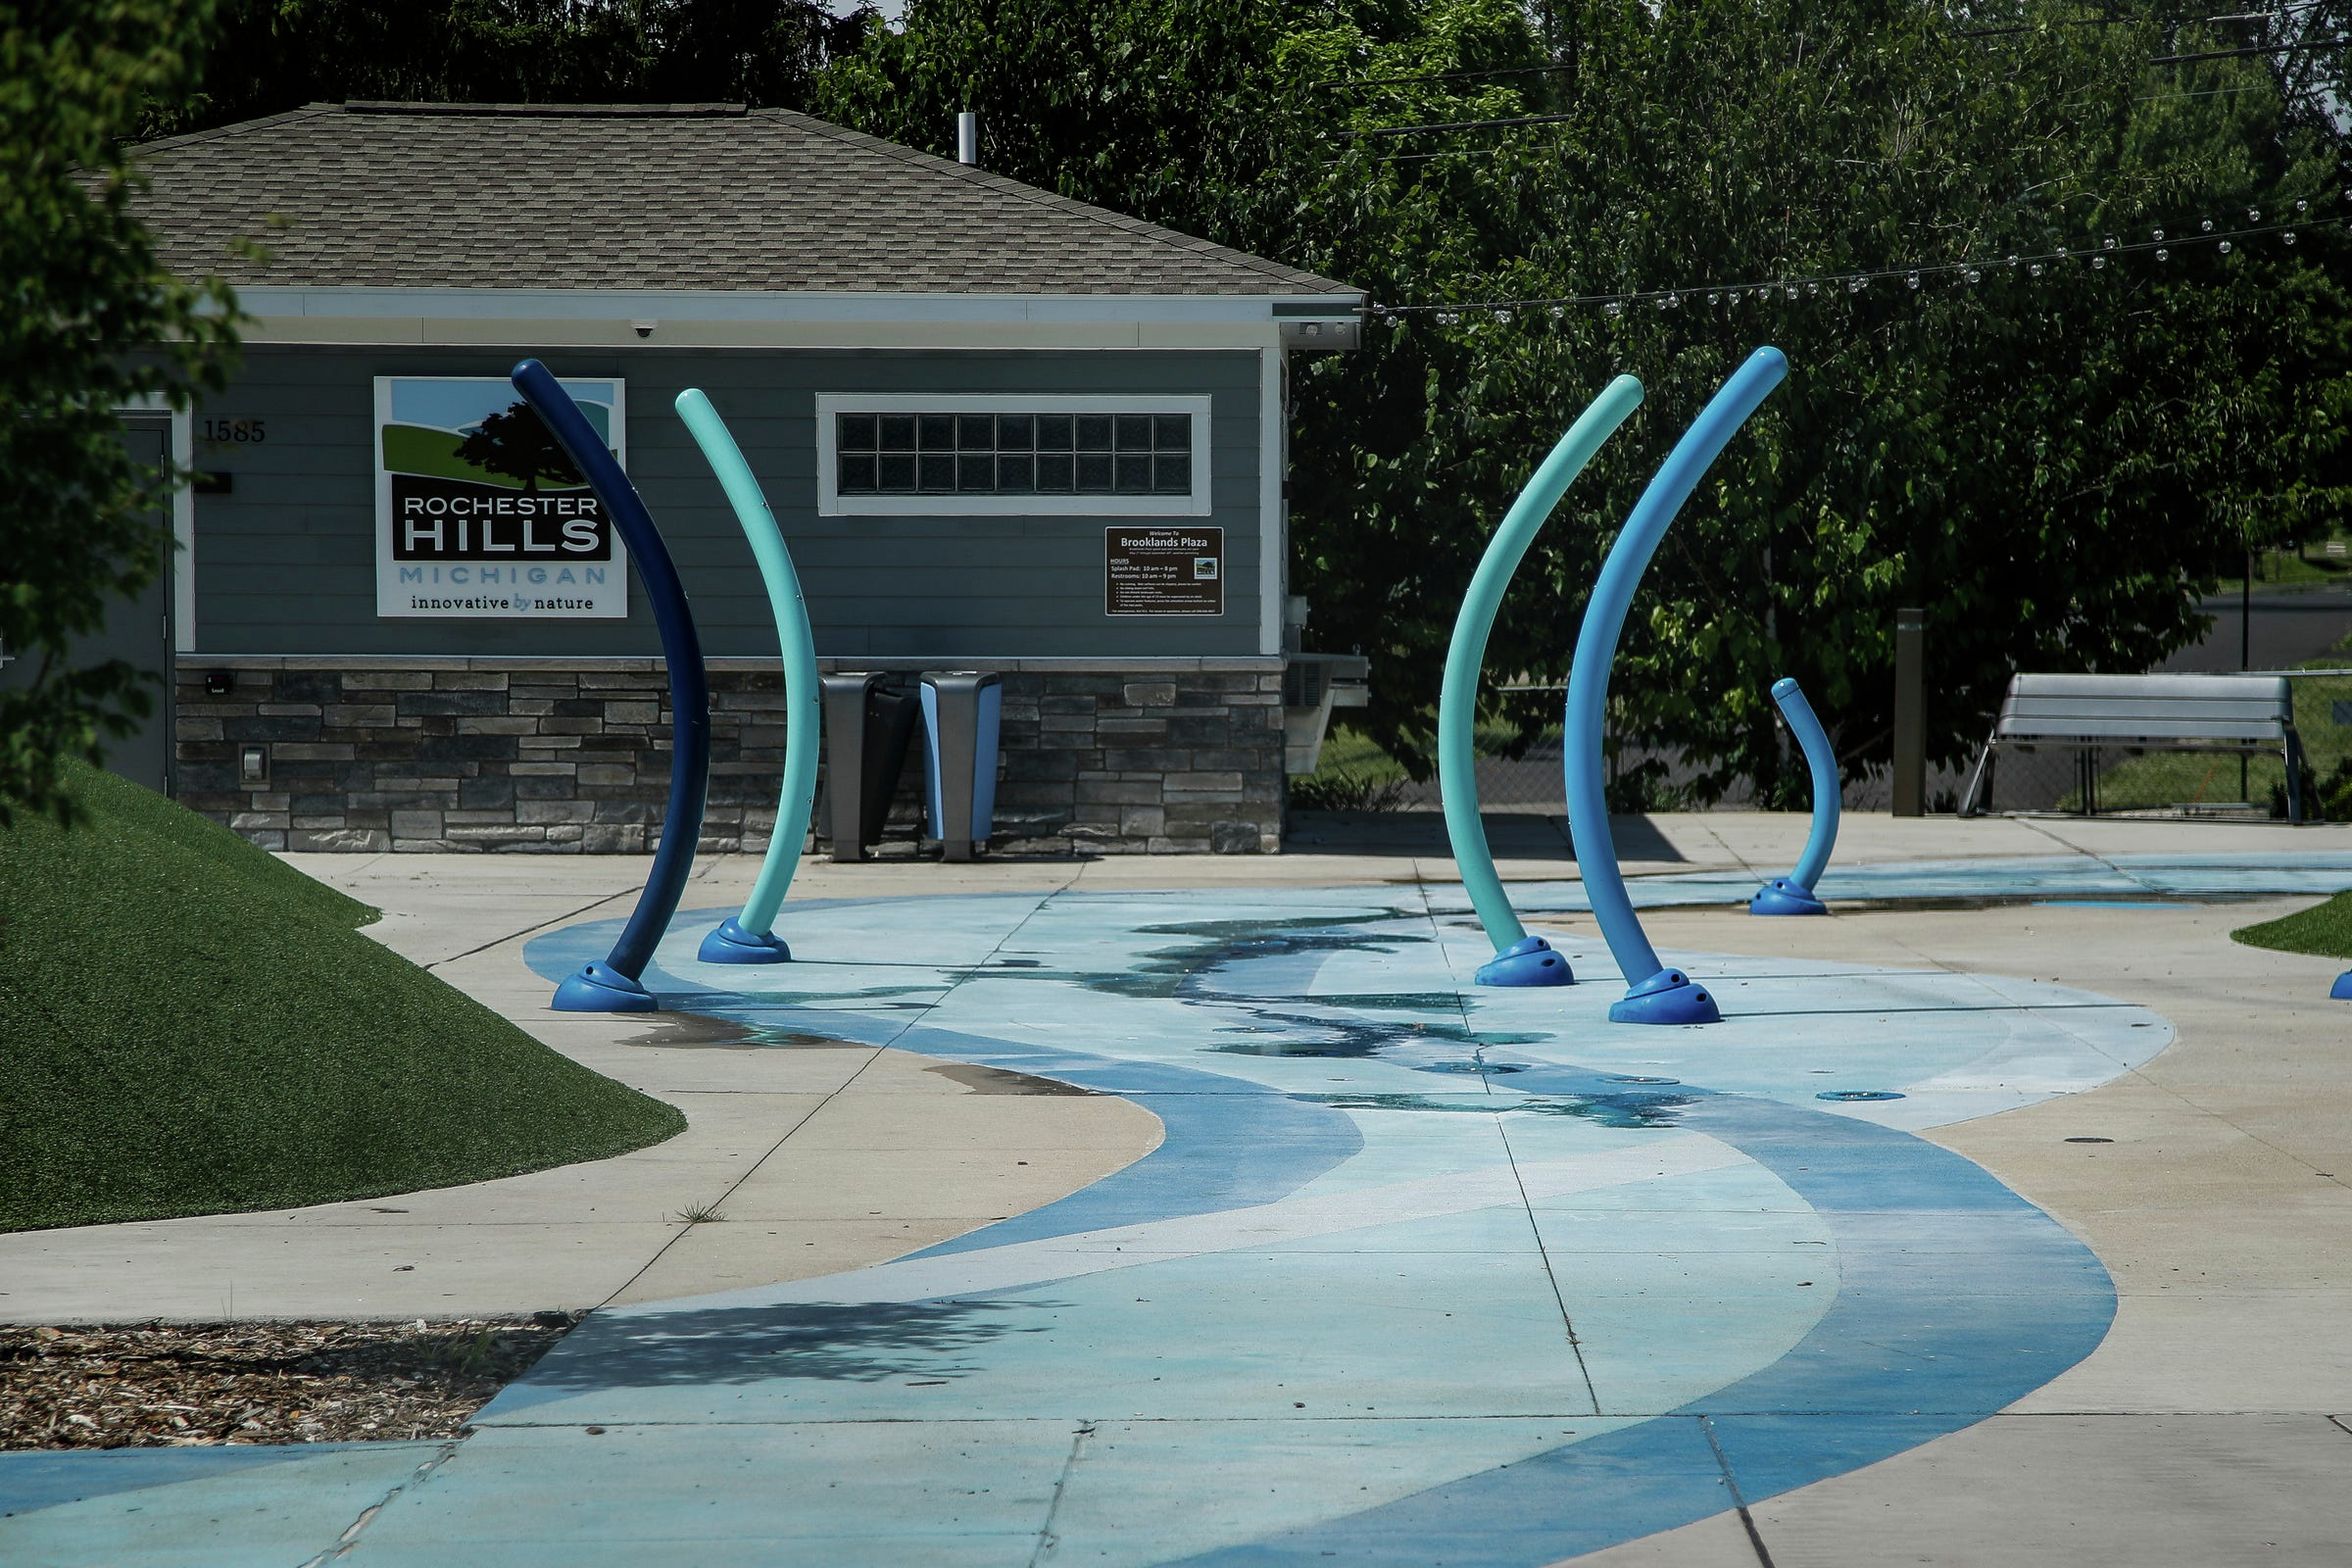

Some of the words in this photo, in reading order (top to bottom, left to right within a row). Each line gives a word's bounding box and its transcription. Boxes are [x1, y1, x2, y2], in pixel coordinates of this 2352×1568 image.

[205, 419, 266, 442] 1585
[404, 497, 598, 515] ROCHESTER
[405, 519, 600, 553] HILLS
[1121, 537, 1178, 547] Brooklands
[1181, 537, 1207, 547] Plaza
[400, 566, 606, 585] MICHIGAN
[412, 595, 510, 610] innovative
[513, 593, 531, 612] by
[534, 597, 594, 610] nature
